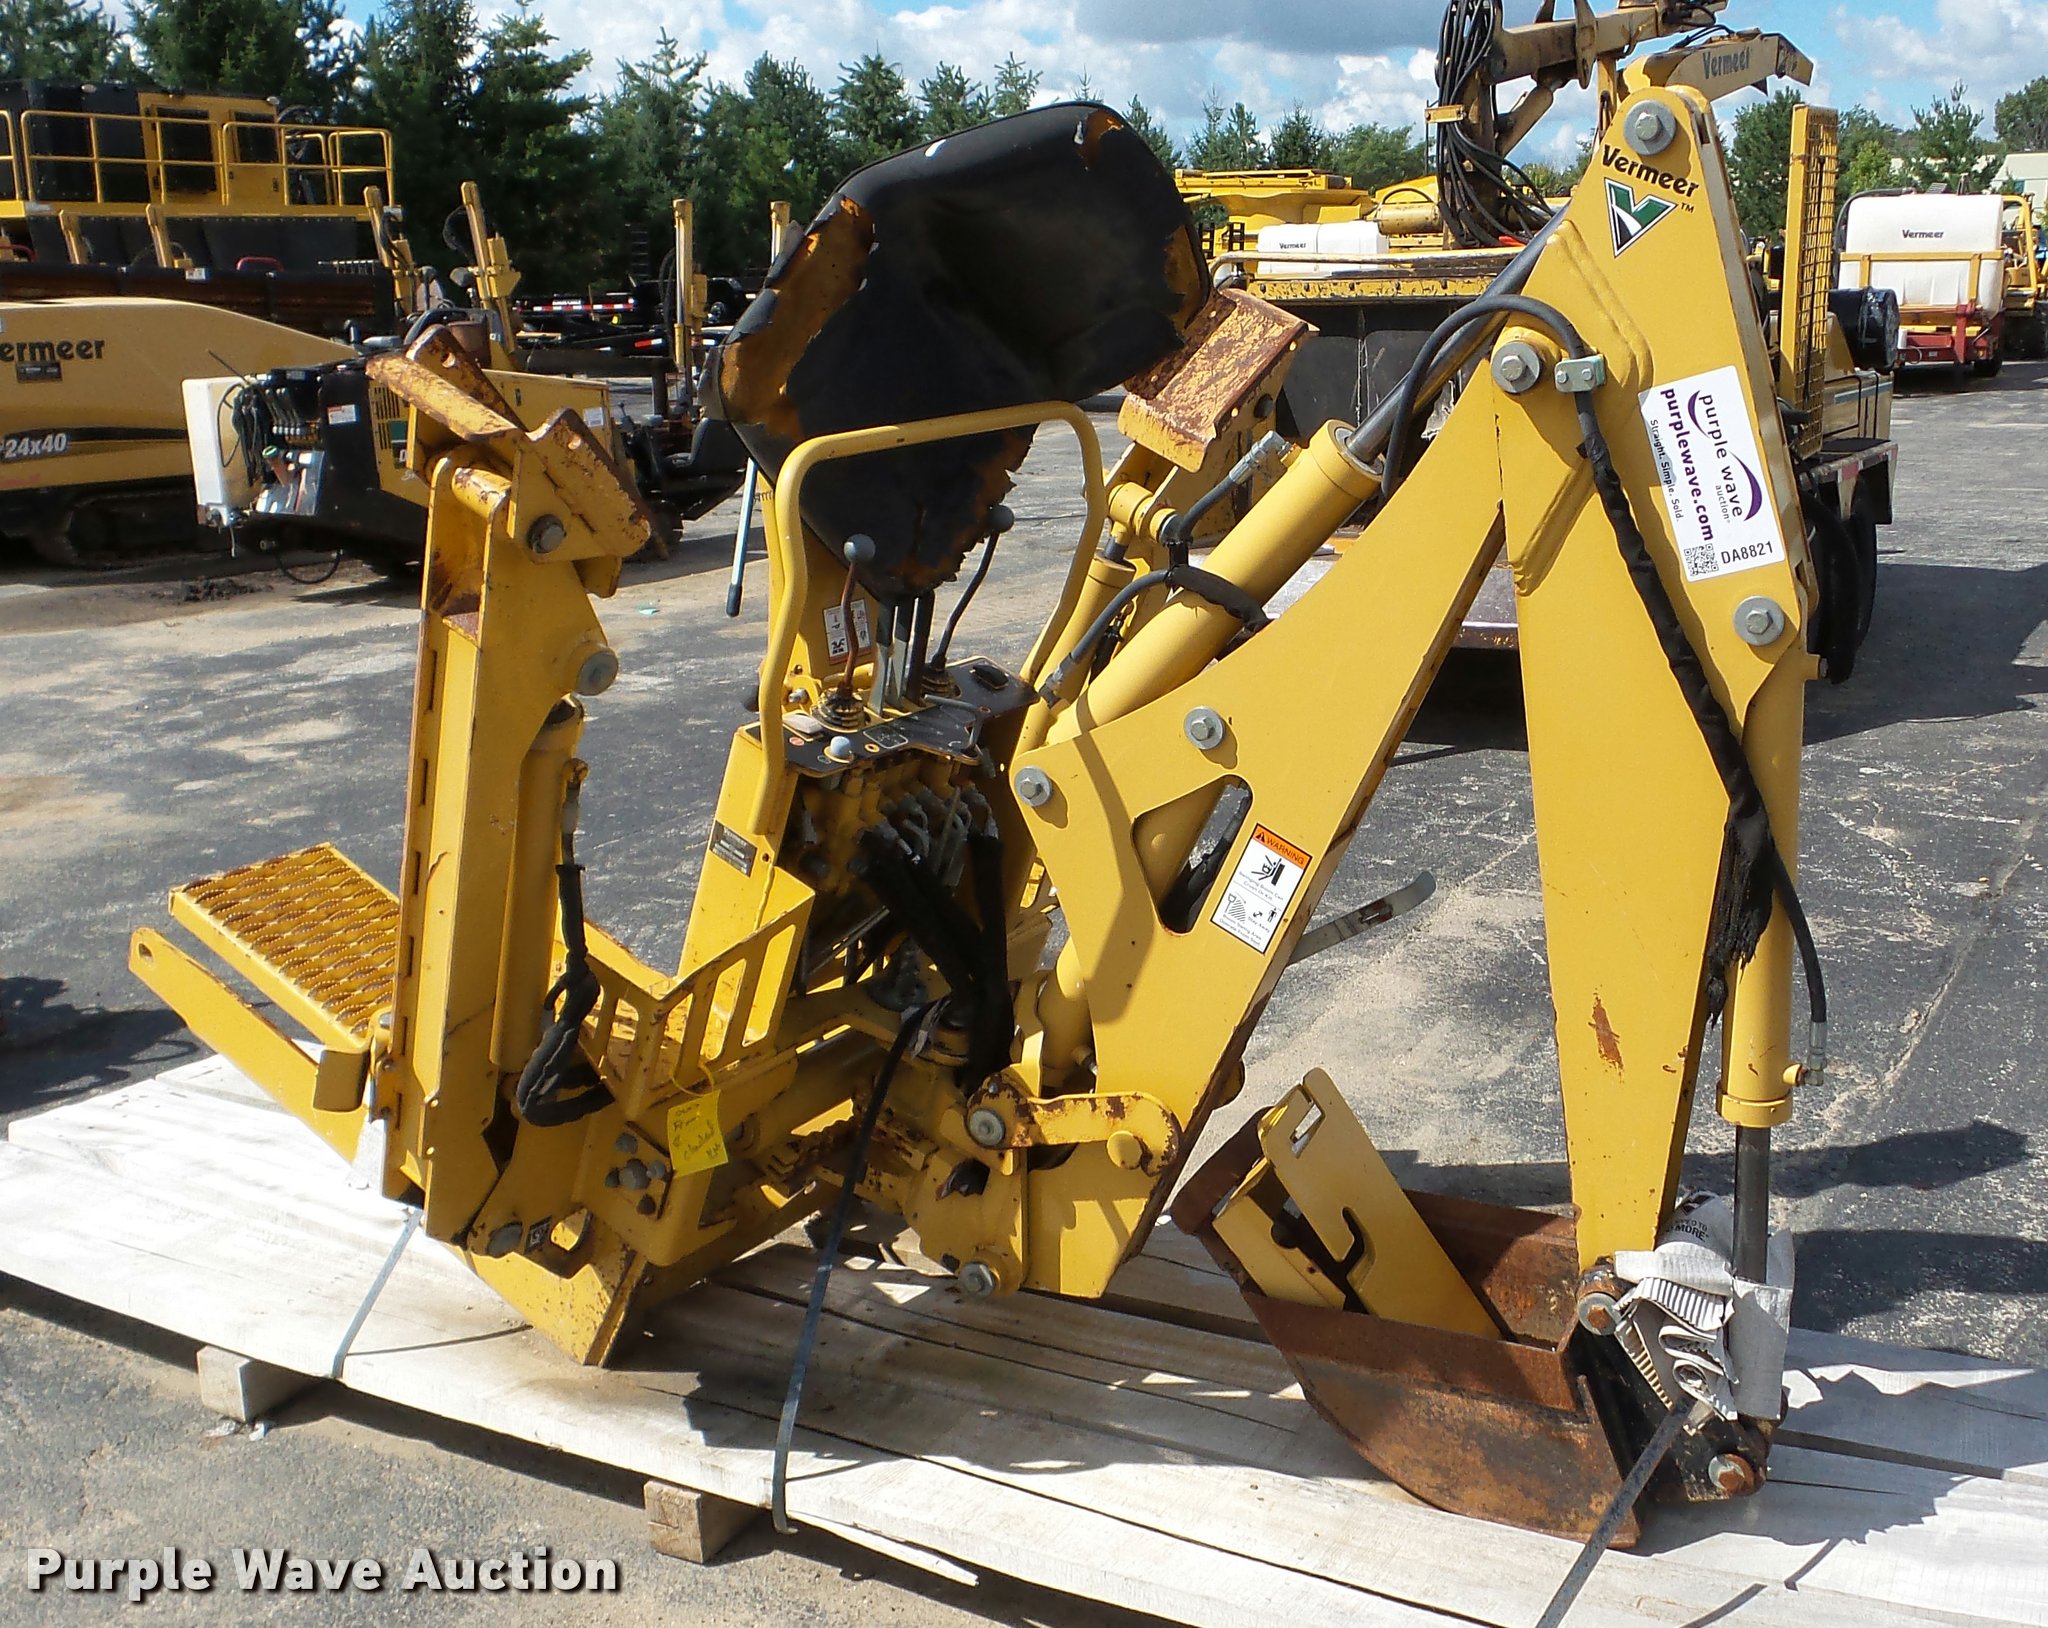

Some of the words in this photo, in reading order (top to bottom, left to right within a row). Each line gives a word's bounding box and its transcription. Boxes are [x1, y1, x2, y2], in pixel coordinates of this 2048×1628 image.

[1702, 48, 1750, 79] Vermeer
[1602, 144, 1699, 197] Vermeer
[1902, 229, 1944, 239] Vermeer
[1650, 420, 1665, 460] Straight.
[1661, 461, 1675, 496] Simple.
[1671, 498, 1684, 522] Sold.
[1660, 388, 1714, 541] purplewave.com
[1699, 394, 1728, 459] purple
[1721, 466, 1743, 517] wave
[1721, 541, 1774, 564] DA8821
[1266, 838, 1305, 865] WARNING
